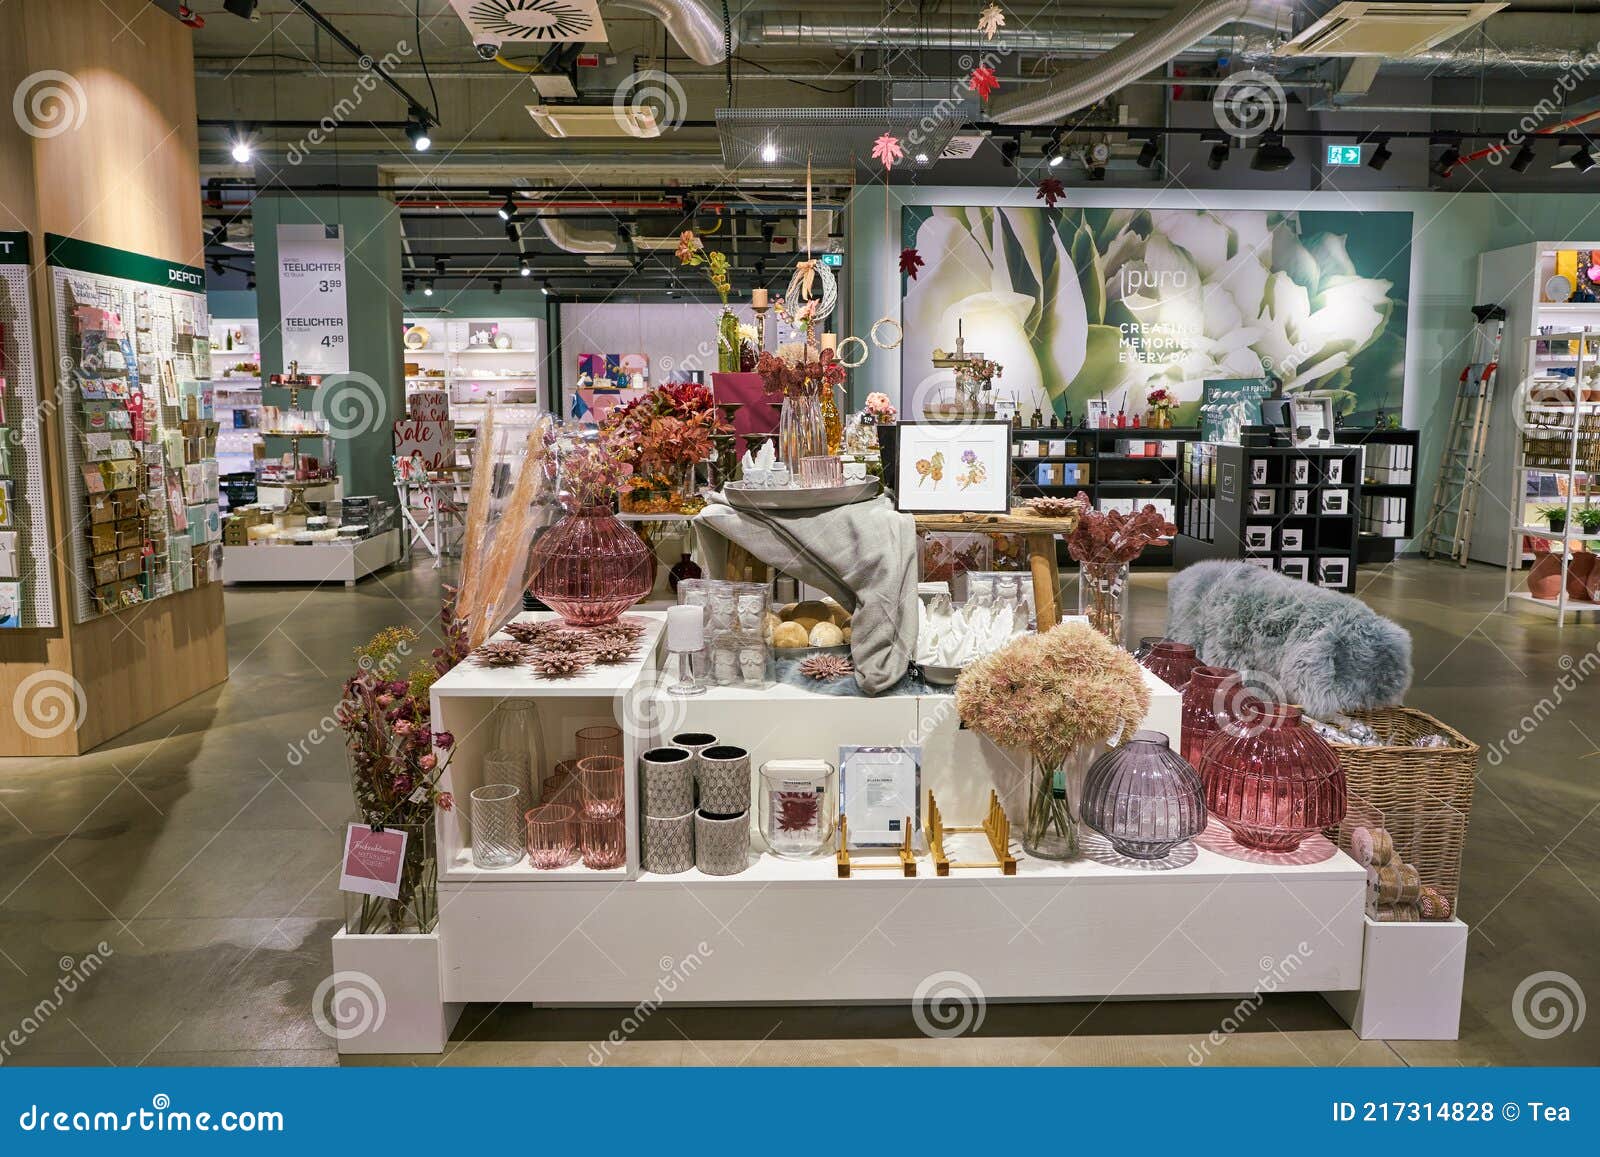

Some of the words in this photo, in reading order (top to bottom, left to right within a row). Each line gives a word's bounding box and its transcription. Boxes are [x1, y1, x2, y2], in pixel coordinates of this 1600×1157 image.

[283, 263, 341, 272] TEELICHTER
[168, 268, 202, 286] DEPOT
[319, 280, 342, 293] 3.99
[286, 317, 344, 327] TEELICHTER
[320, 335, 344, 348] 4.99
[1119, 352, 1165, 362] EVERY
[393, 417, 434, 448] Sale
